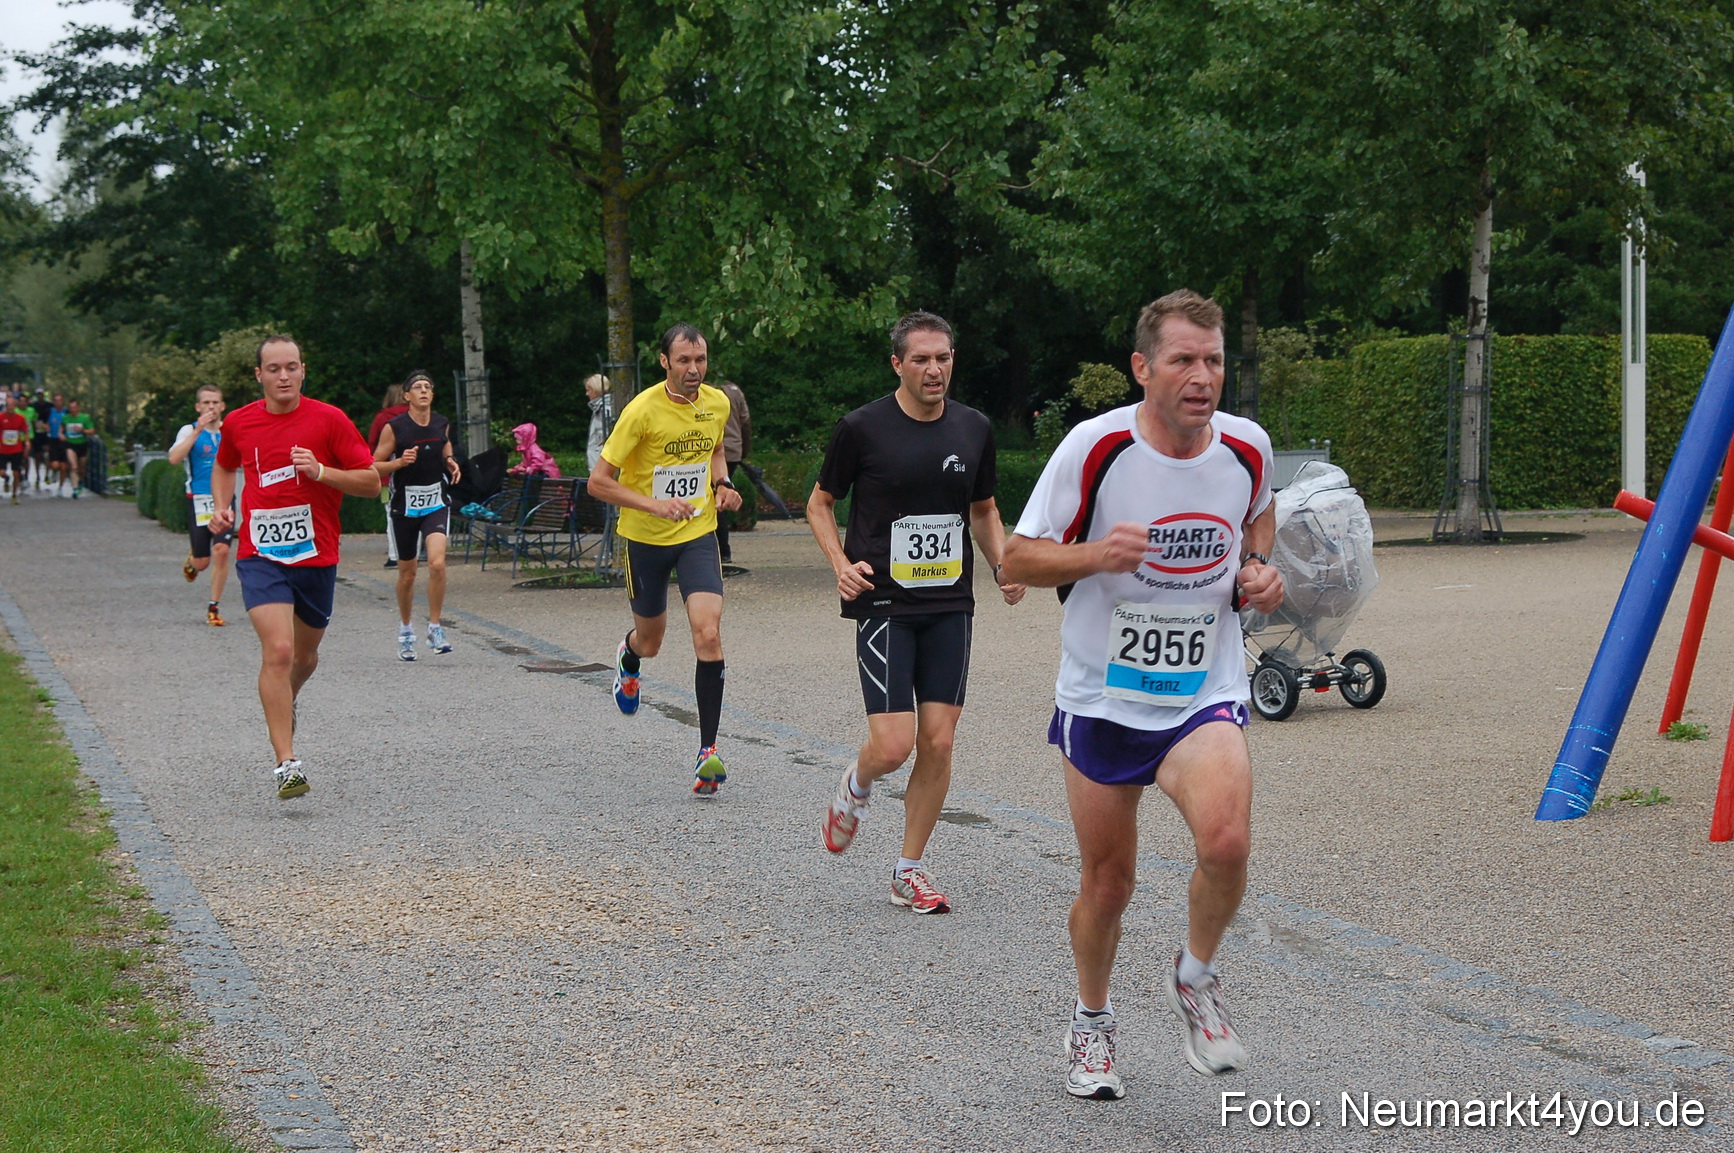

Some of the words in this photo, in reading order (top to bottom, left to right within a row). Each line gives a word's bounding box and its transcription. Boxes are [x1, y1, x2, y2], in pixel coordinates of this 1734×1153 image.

[665, 477, 699, 498] 439
[410, 492, 439, 508] 2577
[270, 511, 300, 520] Neumarkt
[257, 519, 308, 543] 2325
[893, 522, 920, 530] PARTL
[922, 521, 954, 530] Neumarkt
[1147, 528, 1217, 543] RHART
[1218, 531, 1225, 541] &
[269, 546, 301, 557] Andreas
[908, 532, 952, 560] 334
[1161, 543, 1226, 559] JÄNIG
[912, 566, 948, 578] Markus
[1131, 570, 1145, 581] as
[1146, 577, 1190, 591] sportliche
[1114, 608, 1147, 623] PARTL
[1150, 613, 1204, 625] Neumarkt
[1119, 627, 1205, 667] 2956
[1141, 676, 1181, 692] Franz
